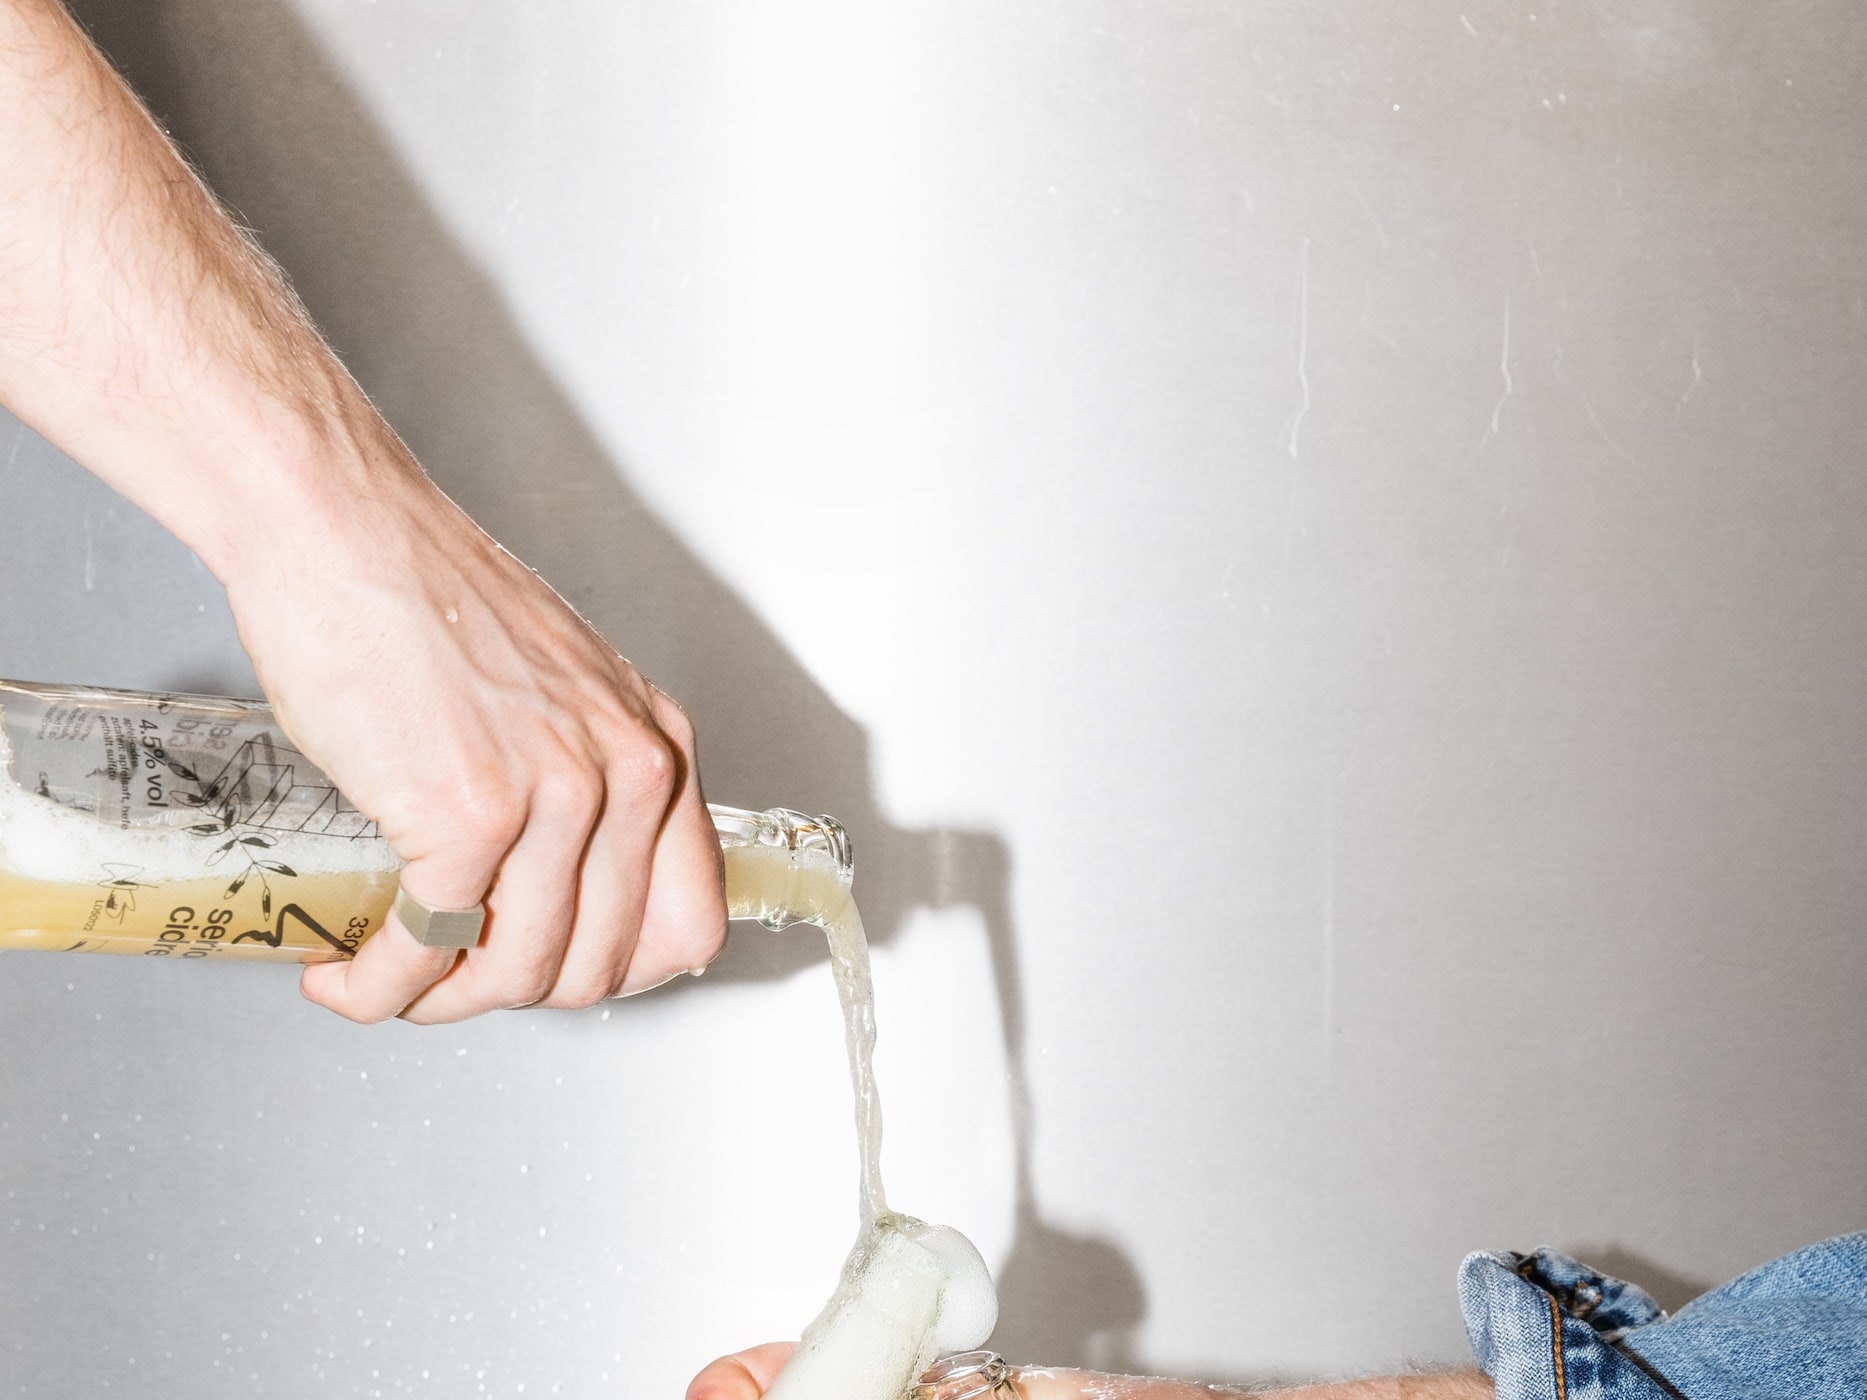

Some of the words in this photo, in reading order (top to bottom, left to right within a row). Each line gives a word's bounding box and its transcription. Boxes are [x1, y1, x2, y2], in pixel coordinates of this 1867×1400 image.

[138, 719, 167, 767] 4.5%
[105, 748, 118, 781] sulfite
[146, 774, 169, 807] vol
